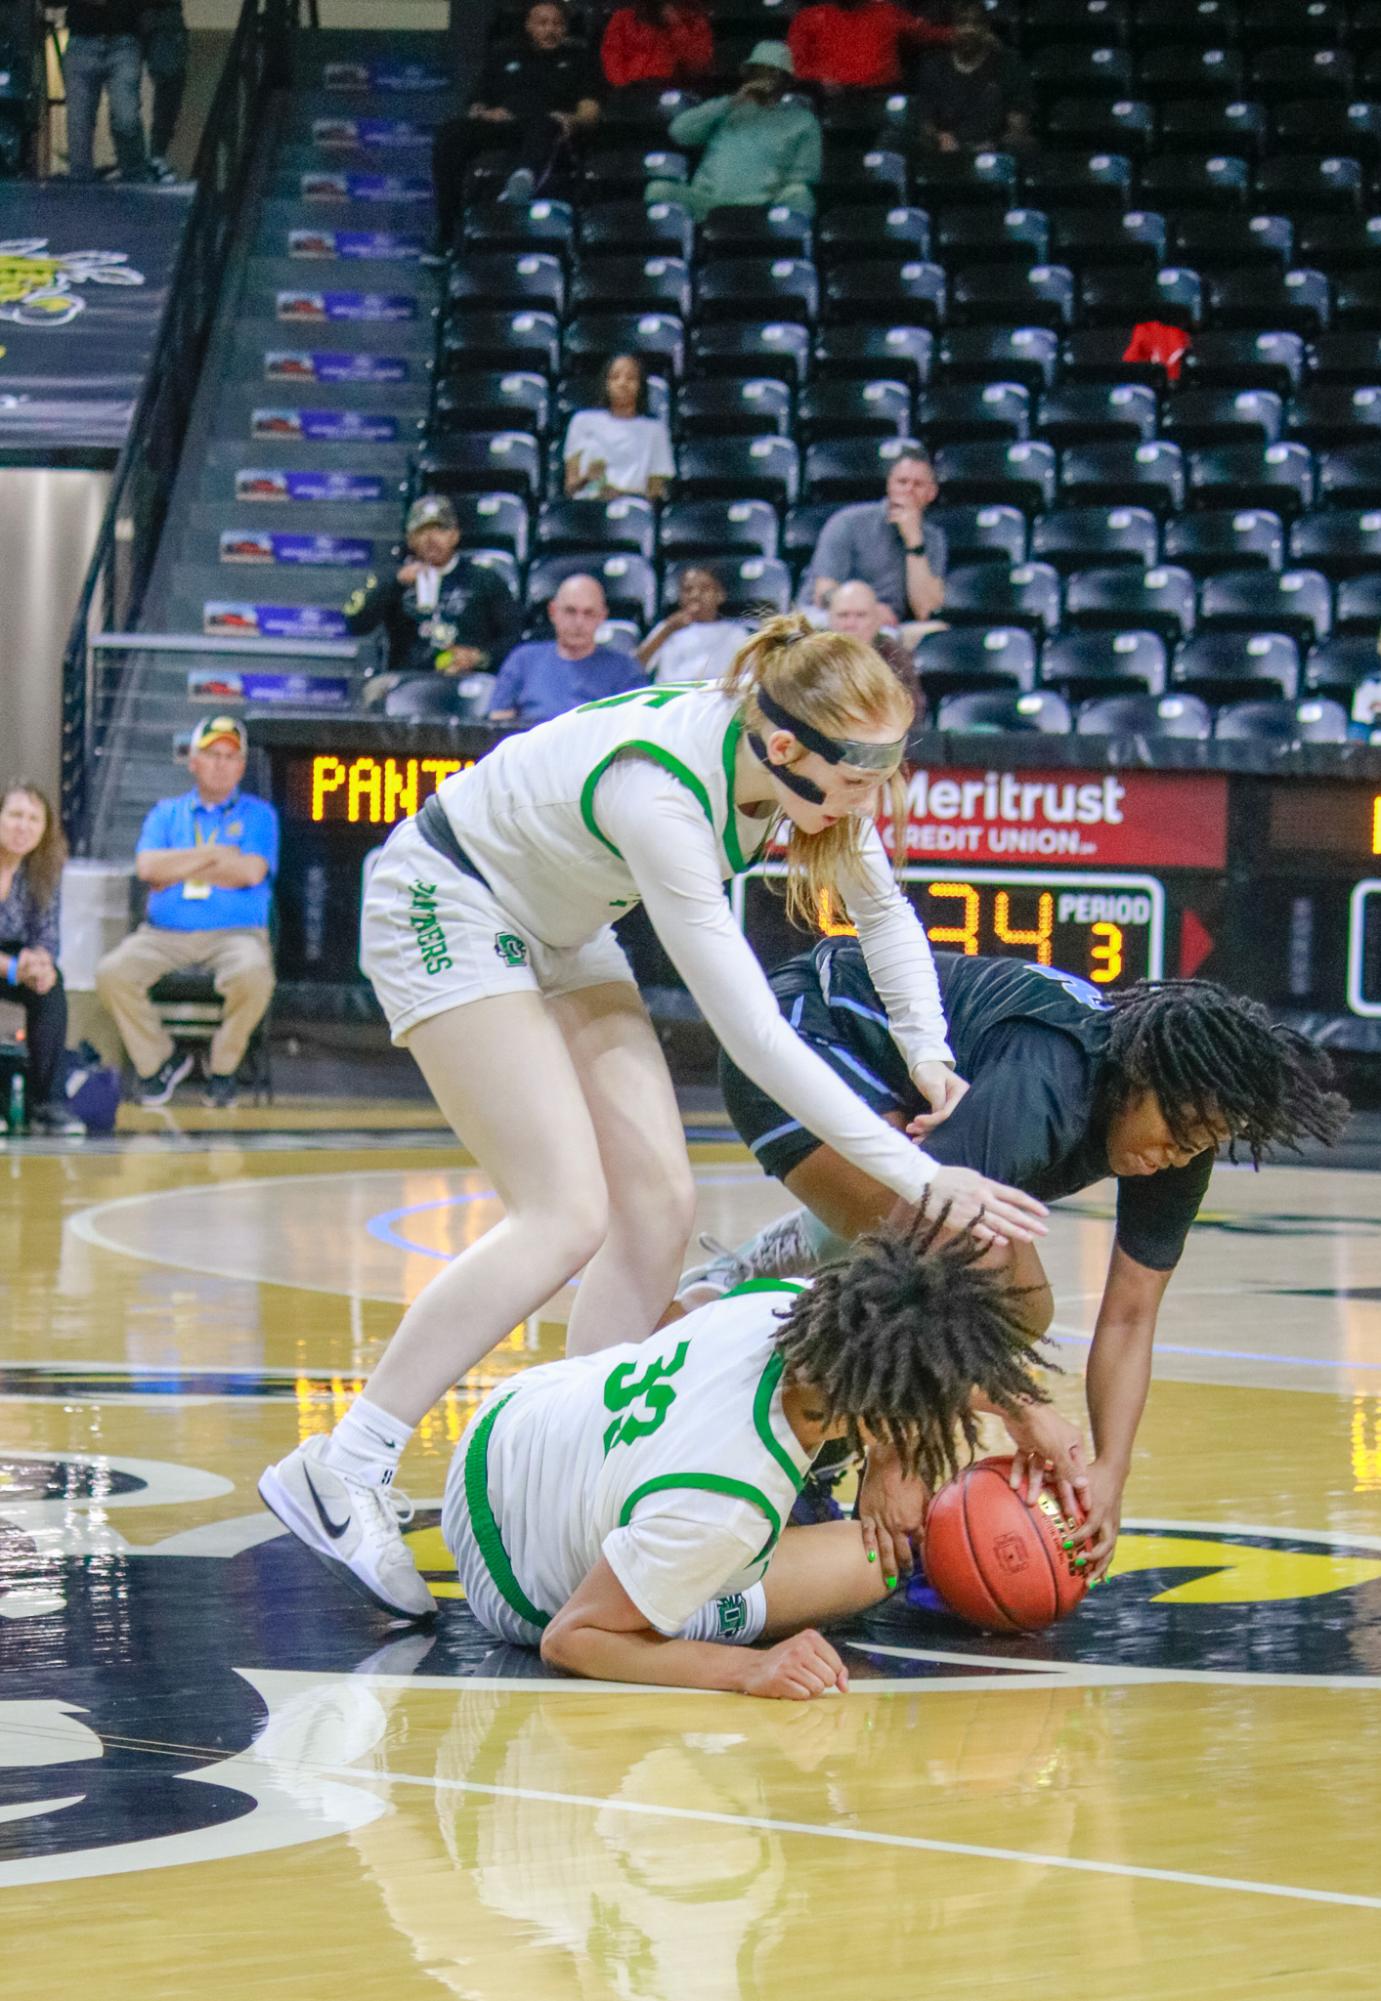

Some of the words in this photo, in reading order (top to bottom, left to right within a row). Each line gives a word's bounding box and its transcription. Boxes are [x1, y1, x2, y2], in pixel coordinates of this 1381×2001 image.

[312, 756, 475, 823] PANT
[882, 770, 1126, 824] Meritrust
[882, 824, 982, 851] CREDIT
[988, 827, 1081, 855] UNION
[1058, 894, 1151, 925] PERIOD
[1090, 921, 1123, 983] 3
